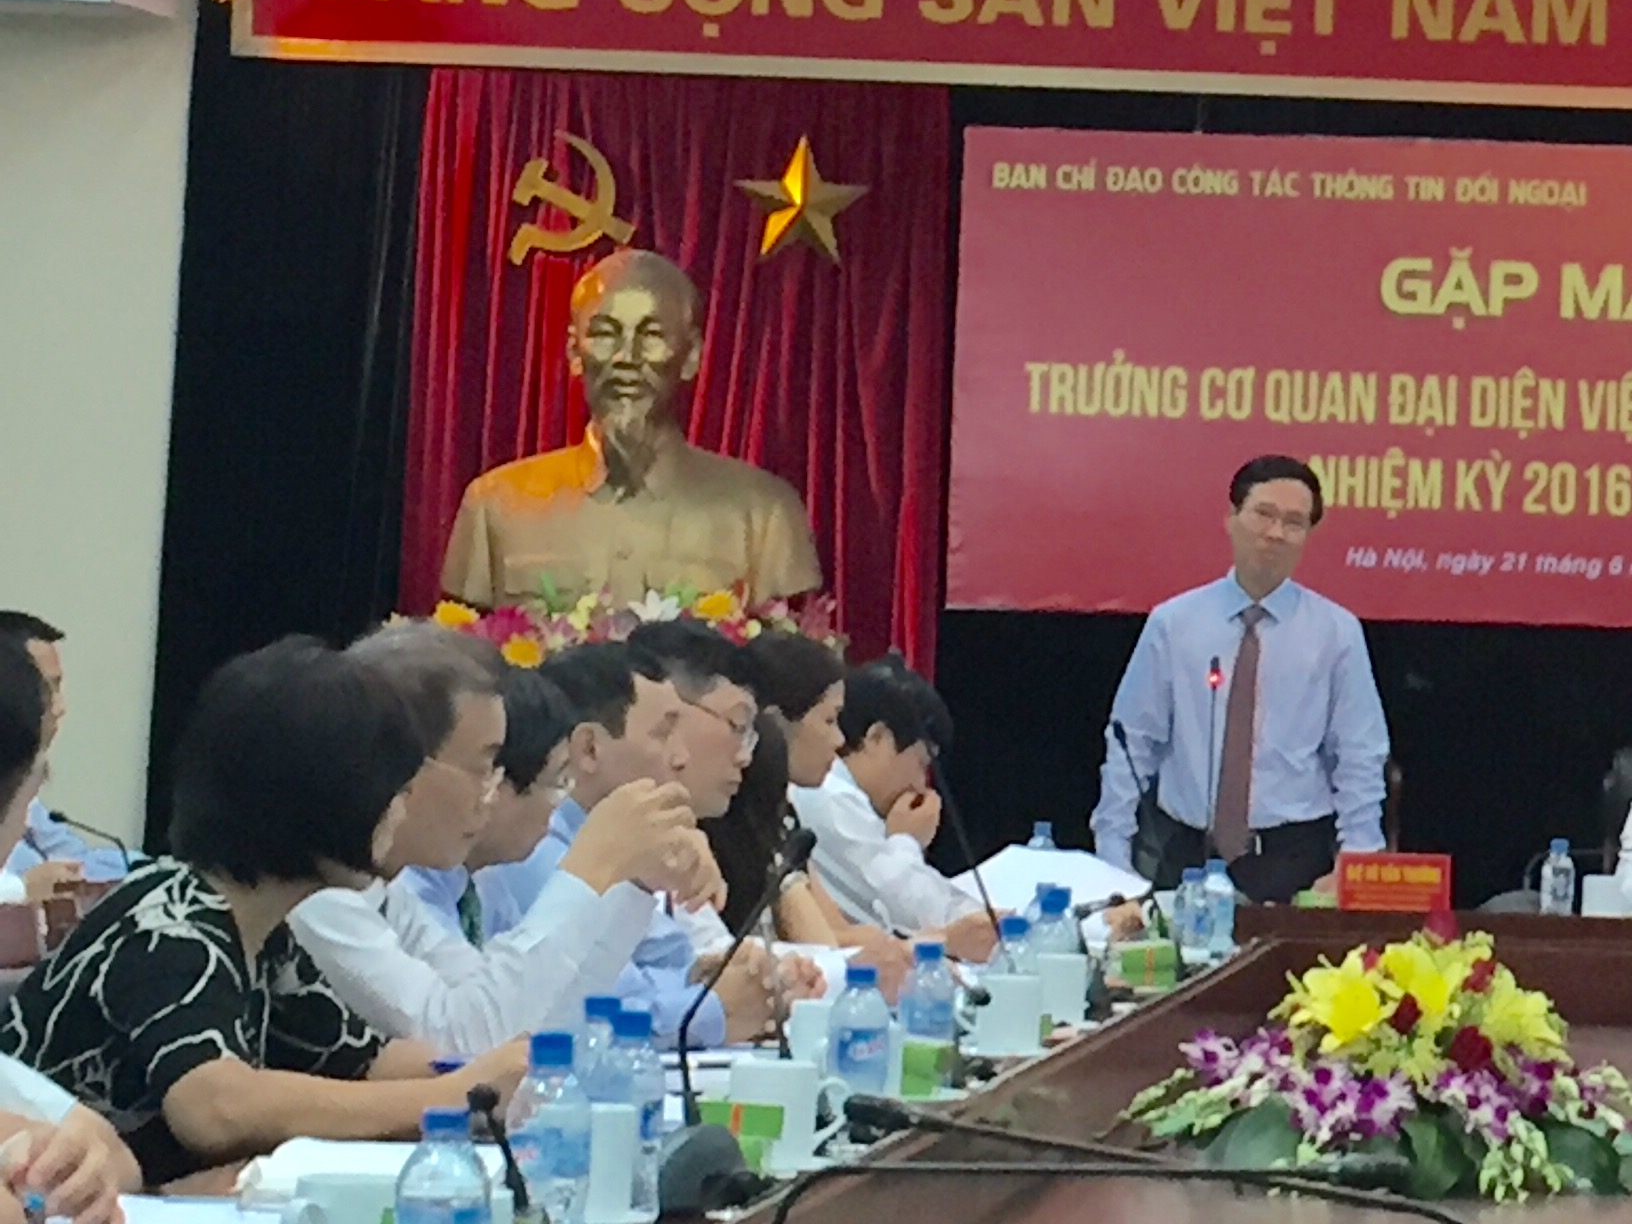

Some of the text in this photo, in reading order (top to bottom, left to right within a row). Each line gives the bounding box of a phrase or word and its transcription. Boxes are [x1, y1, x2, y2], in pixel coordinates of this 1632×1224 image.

[992, 161, 1047, 189] BAN
[1405, 175, 1445, 202] TIN
[1381, 246, 1539, 330] GẶP
[1024, 348, 1188, 418] TRƯỞNG
[1199, 365, 1256, 421] CƠ
[1264, 369, 1378, 425] QUAN
[1388, 373, 1456, 436] ĐẠI
[1469, 366, 1567, 439] DIỆN
[1455, 448, 1512, 511] KỲ
[1522, 461, 1632, 516] 2016
[1345, 546, 1378, 568] Hà
[1499, 551, 1528, 572] 21
[1608, 554, 1624, 576] 6
